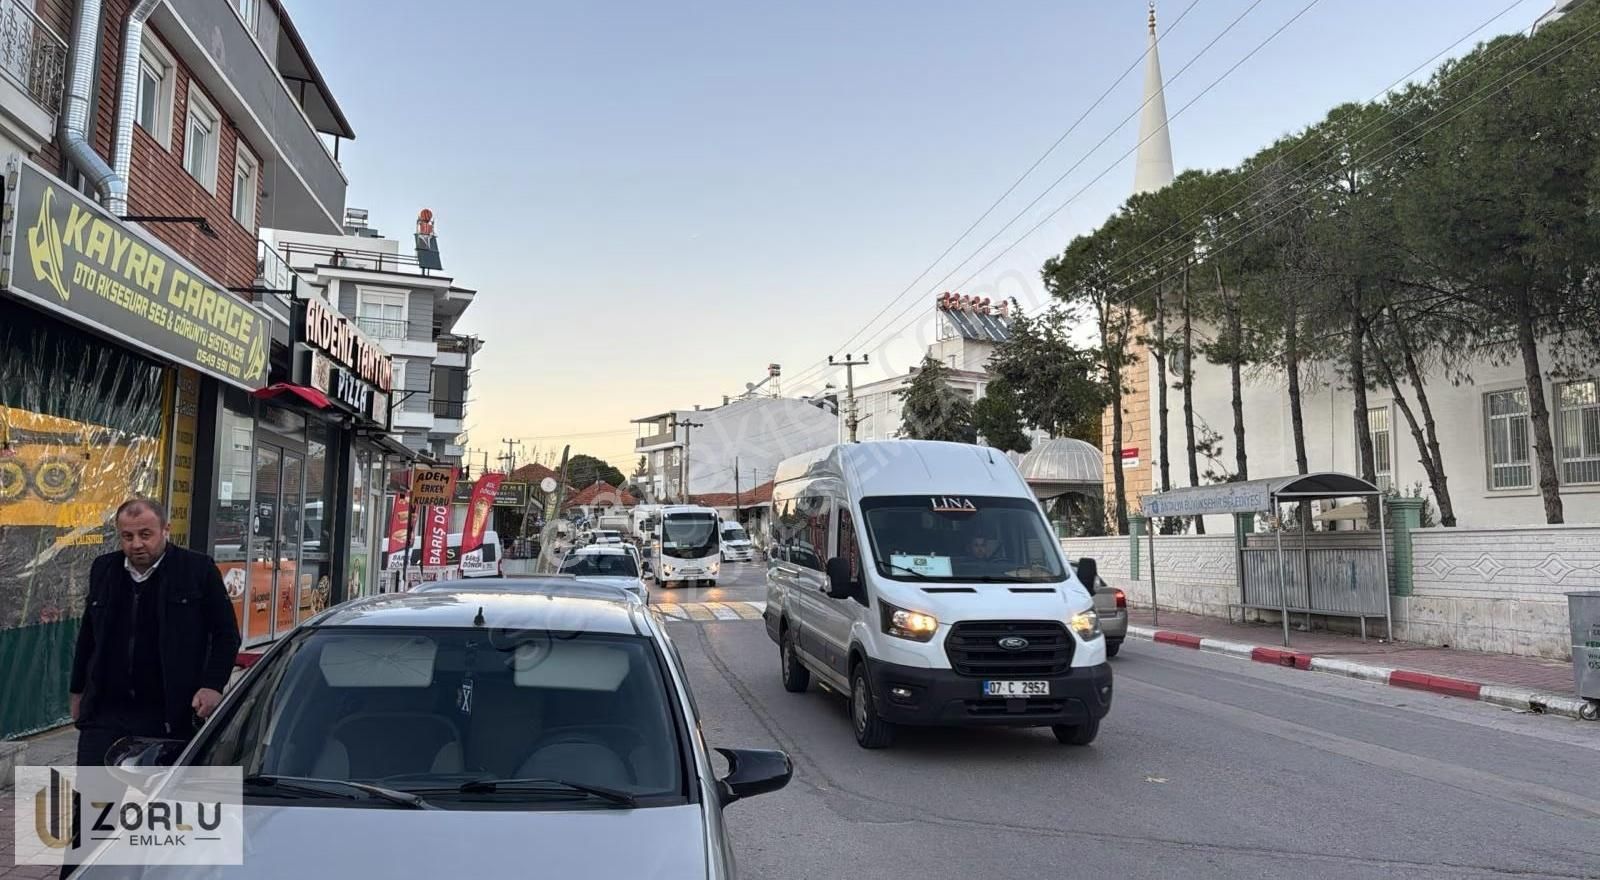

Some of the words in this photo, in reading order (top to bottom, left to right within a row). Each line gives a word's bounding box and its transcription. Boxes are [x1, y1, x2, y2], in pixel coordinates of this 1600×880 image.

[63, 203, 165, 296] KAYRA
[168, 268, 254, 346] GARAGE
[73, 262, 97, 291] OTO
[96, 272, 149, 316] AKSESUAR
[149, 300, 168, 327] SES
[167, 310, 175, 332] &
[196, 348, 216, 367] 0549
[338, 369, 368, 414] PİZZA
[416, 471, 450, 485] ADEM
[420, 484, 445, 494] ERKEK
[930, 496, 976, 509] LİNA
[429, 527, 447, 565] BARIŞ
[990, 682, 1001, 694] 07
[1008, 682, 1015, 693] C
[1022, 682, 1047, 694] 2952
